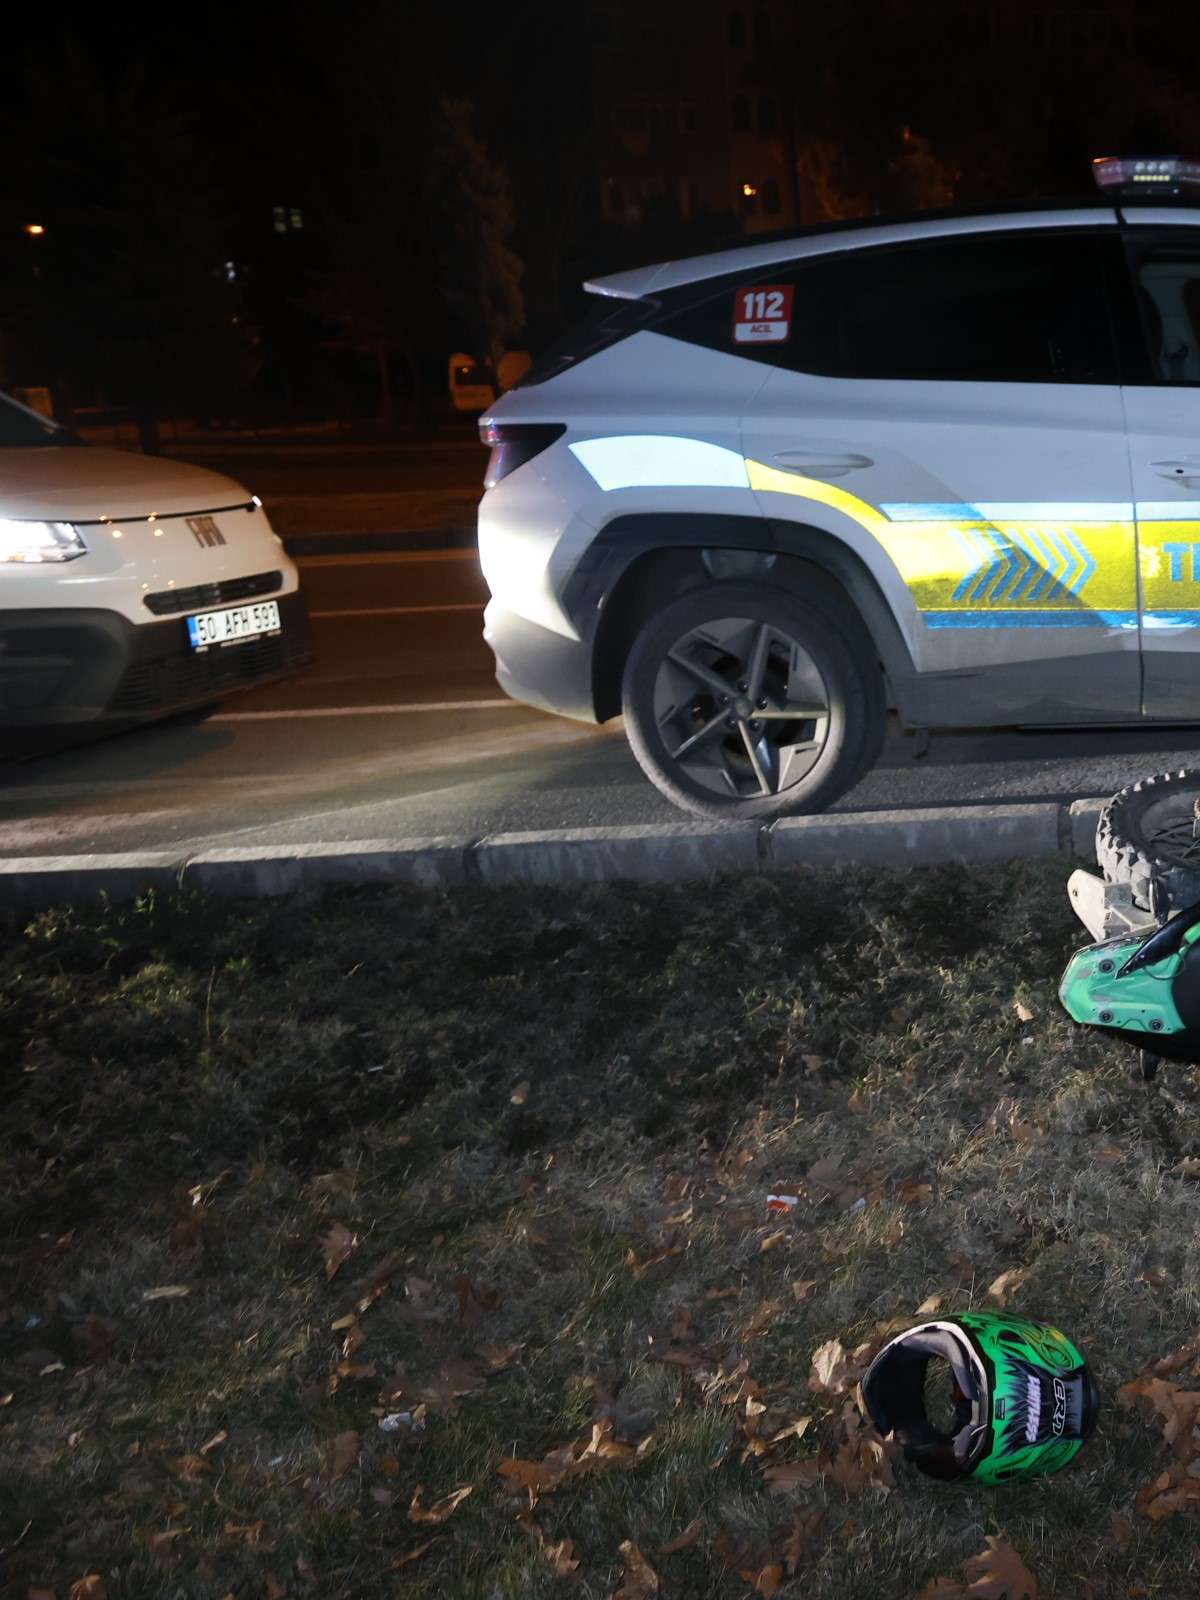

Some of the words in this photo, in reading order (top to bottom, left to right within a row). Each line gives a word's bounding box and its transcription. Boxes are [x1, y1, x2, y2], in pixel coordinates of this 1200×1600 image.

[743, 291, 785, 319] 112
[198, 617, 217, 641] 50
[225, 609, 250, 636] AFH
